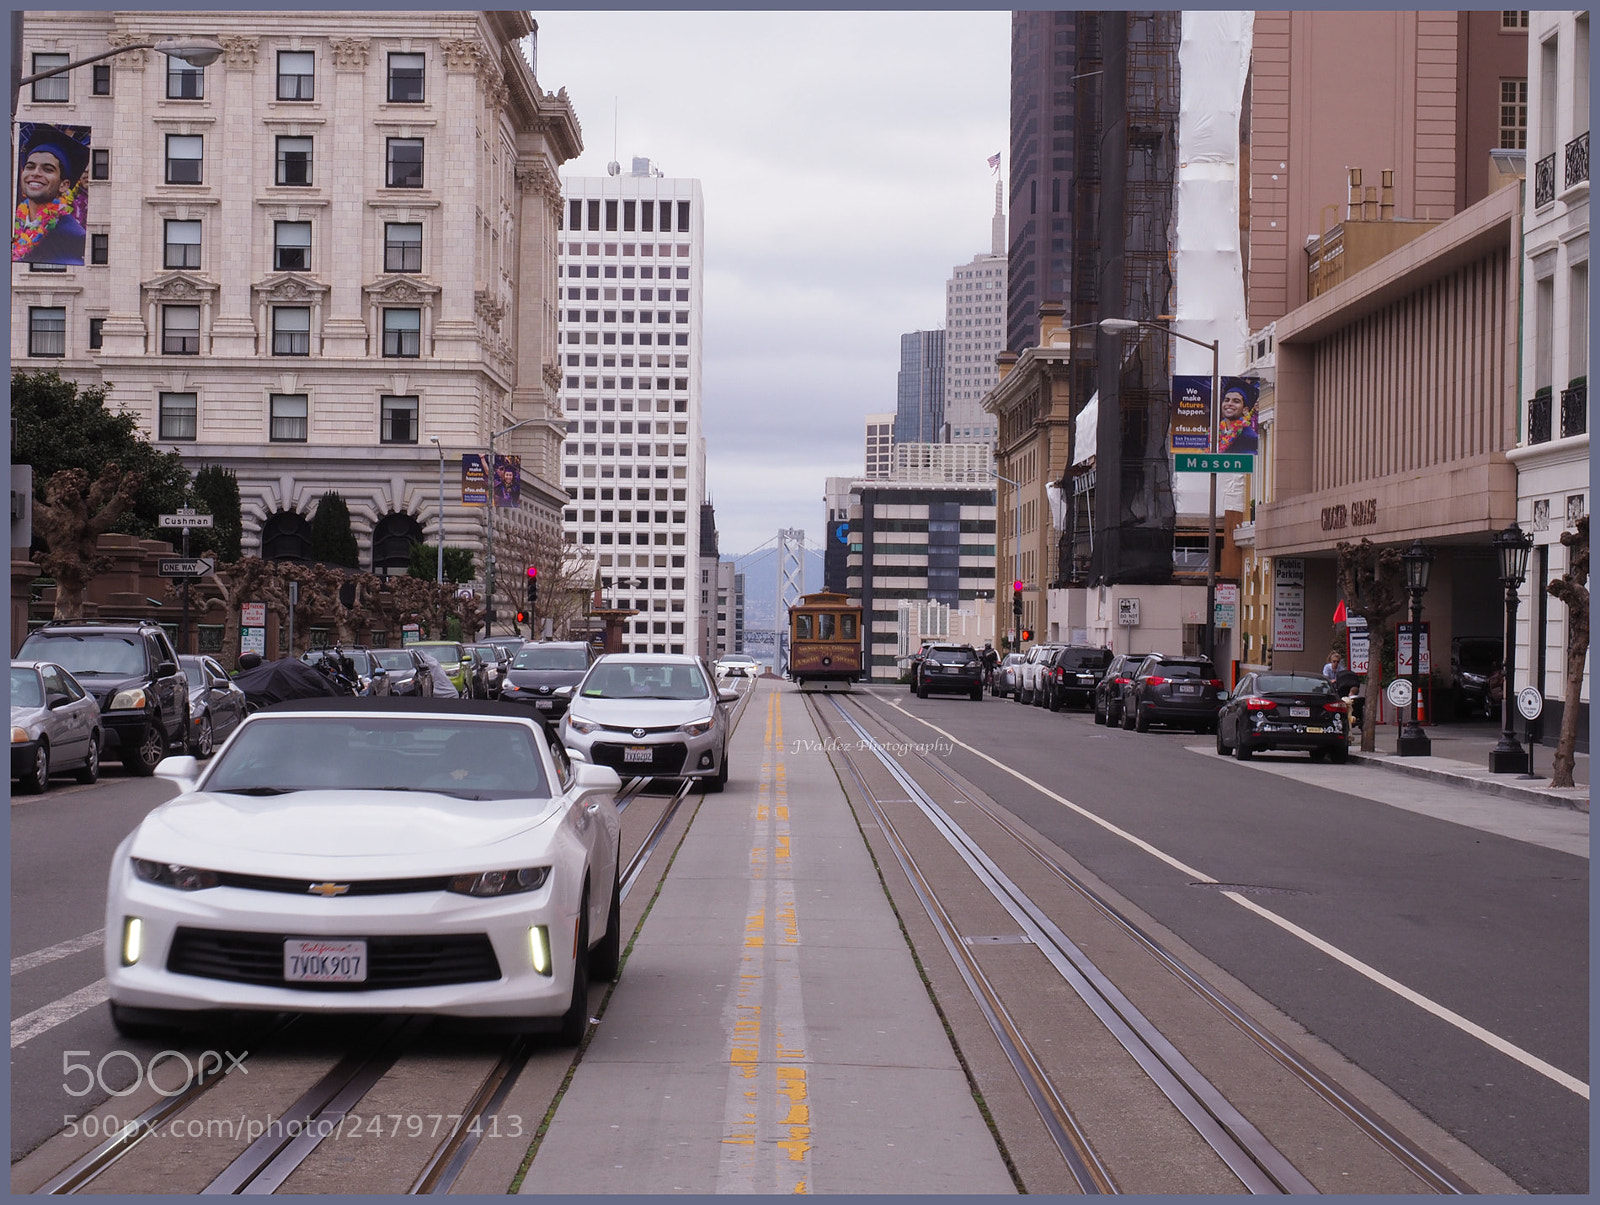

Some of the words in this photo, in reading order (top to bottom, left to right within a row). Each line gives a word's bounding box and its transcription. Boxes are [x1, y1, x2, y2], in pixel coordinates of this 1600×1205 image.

[1177, 408, 1206, 416] happen.
[1176, 424, 1206, 432] sfsu.edu
[1187, 458, 1242, 468] Mason
[1280, 560, 1301, 568] Public
[1276, 570, 1303, 580] Parking
[302, 944, 346, 955] California
